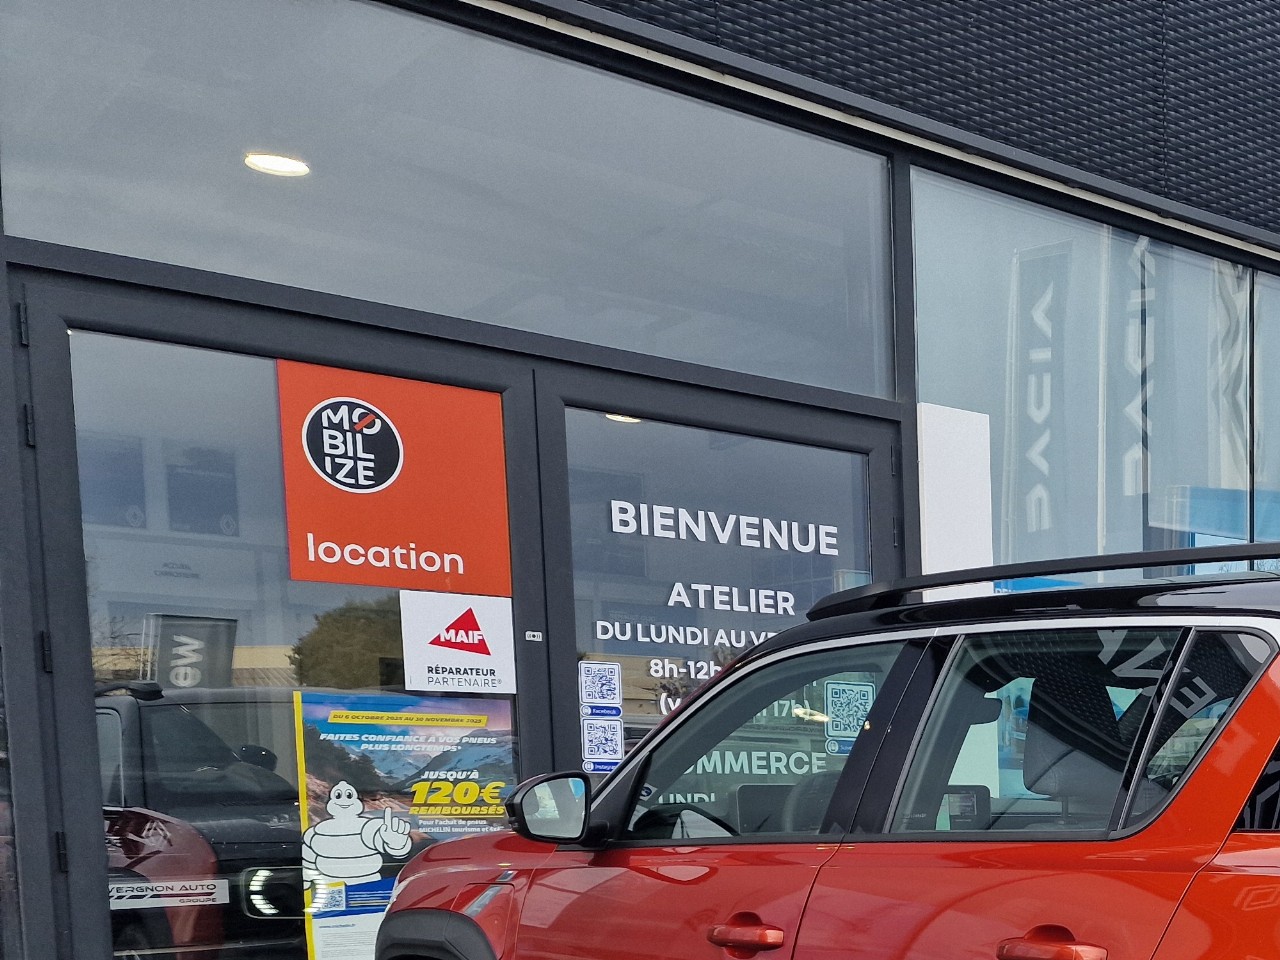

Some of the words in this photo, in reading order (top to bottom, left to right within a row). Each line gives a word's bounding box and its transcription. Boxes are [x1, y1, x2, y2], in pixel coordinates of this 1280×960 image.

[610, 499, 839, 556] BIENVENUE
[306, 532, 464, 575] location
[667, 582, 795, 616] ATELIER
[440, 628, 484, 644] MAIF
[596, 620, 631, 640] DU
[636, 623, 708, 646] LUNDI
[713, 628, 746, 648] AU
[427, 664, 496, 677] RÉPARATEUR
[319, 733, 360, 741] FAITES
[361, 734, 427, 743] CONFIANCE
[360, 743, 392, 751] PLUS
[410, 781, 506, 805] 120€
[408, 805, 505, 815] REMBOURSÉS
[178, 883, 217, 892] AUTO
